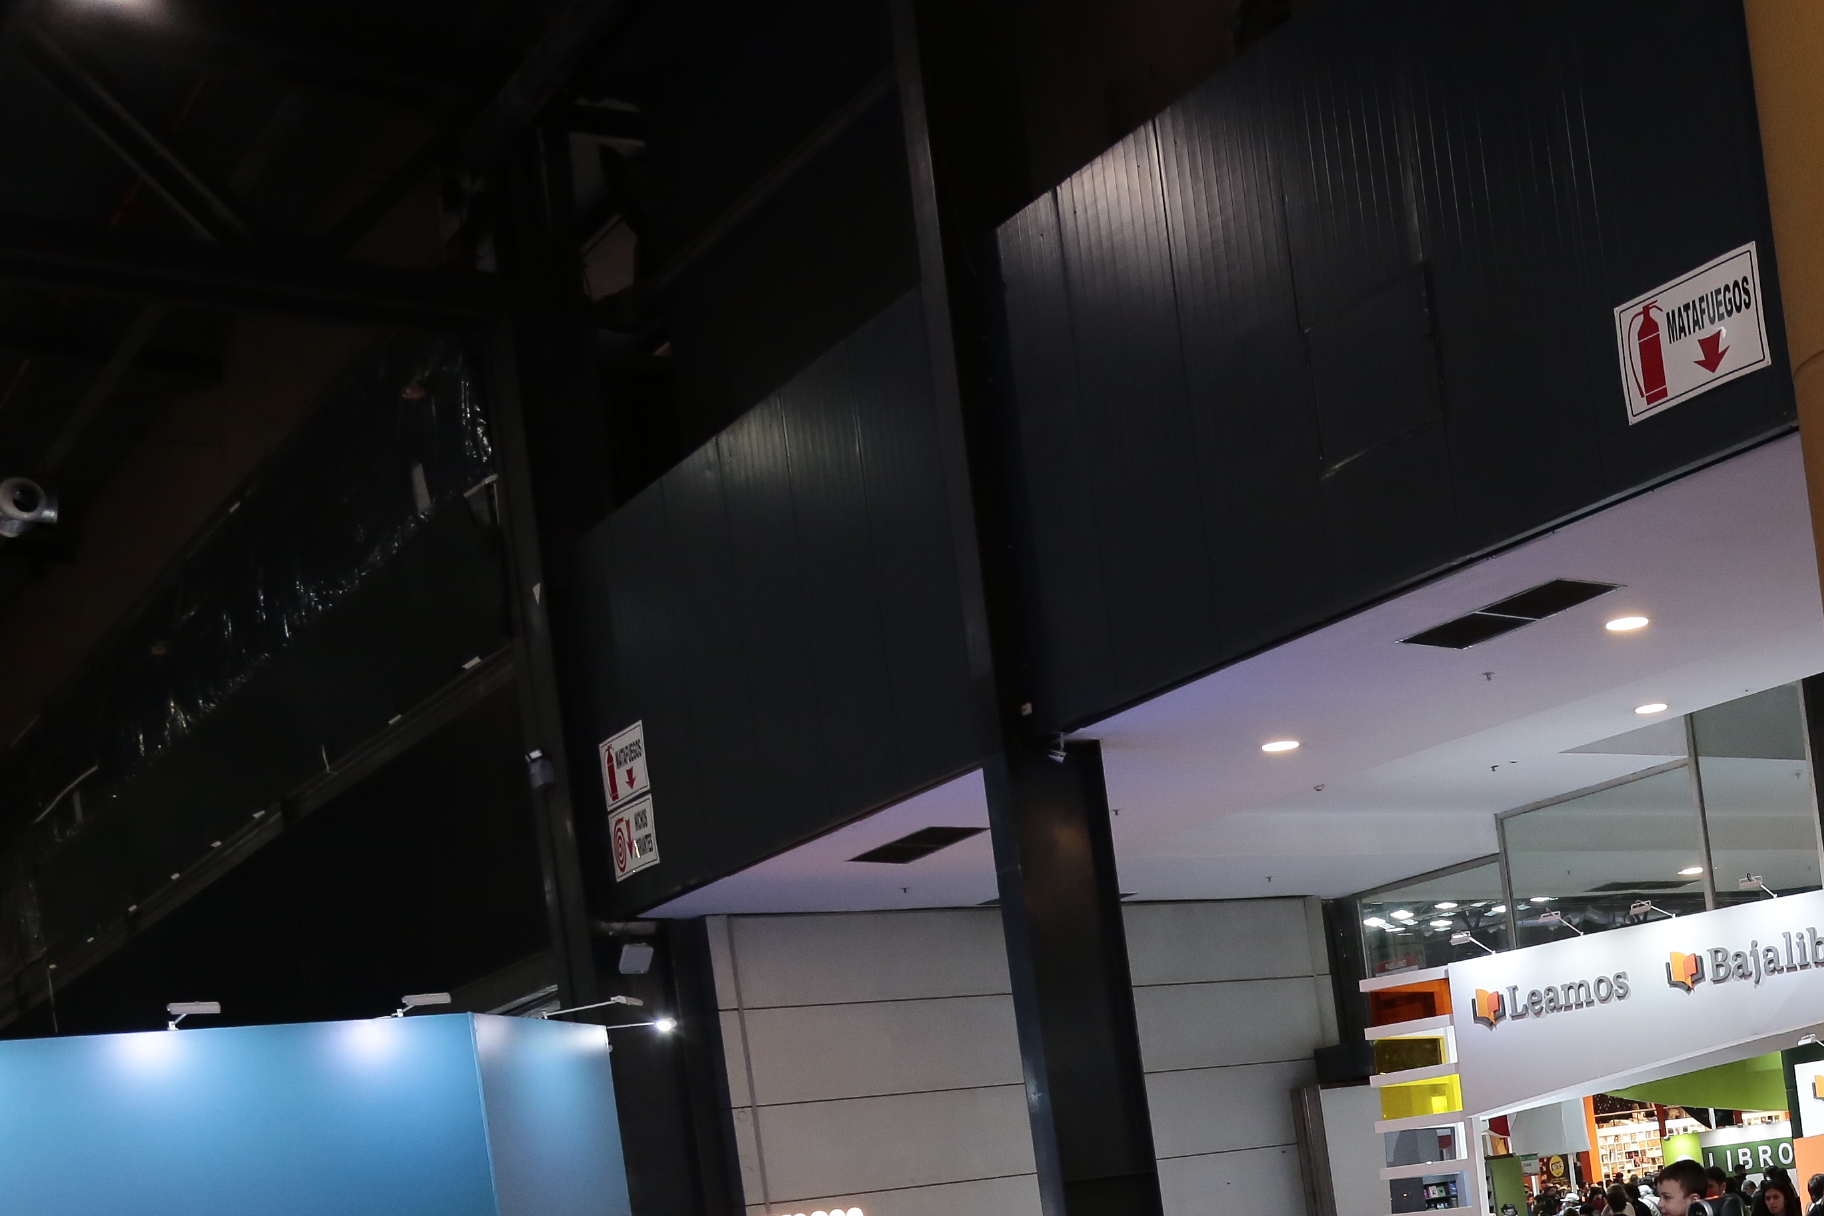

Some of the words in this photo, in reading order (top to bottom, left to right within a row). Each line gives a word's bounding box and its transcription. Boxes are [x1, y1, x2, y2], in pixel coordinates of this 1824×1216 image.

[1666, 275, 1752, 344] MATAFUEGOS
[1506, 968, 1630, 1020] Leamos
[1708, 1142, 1794, 1173] LIBRO
